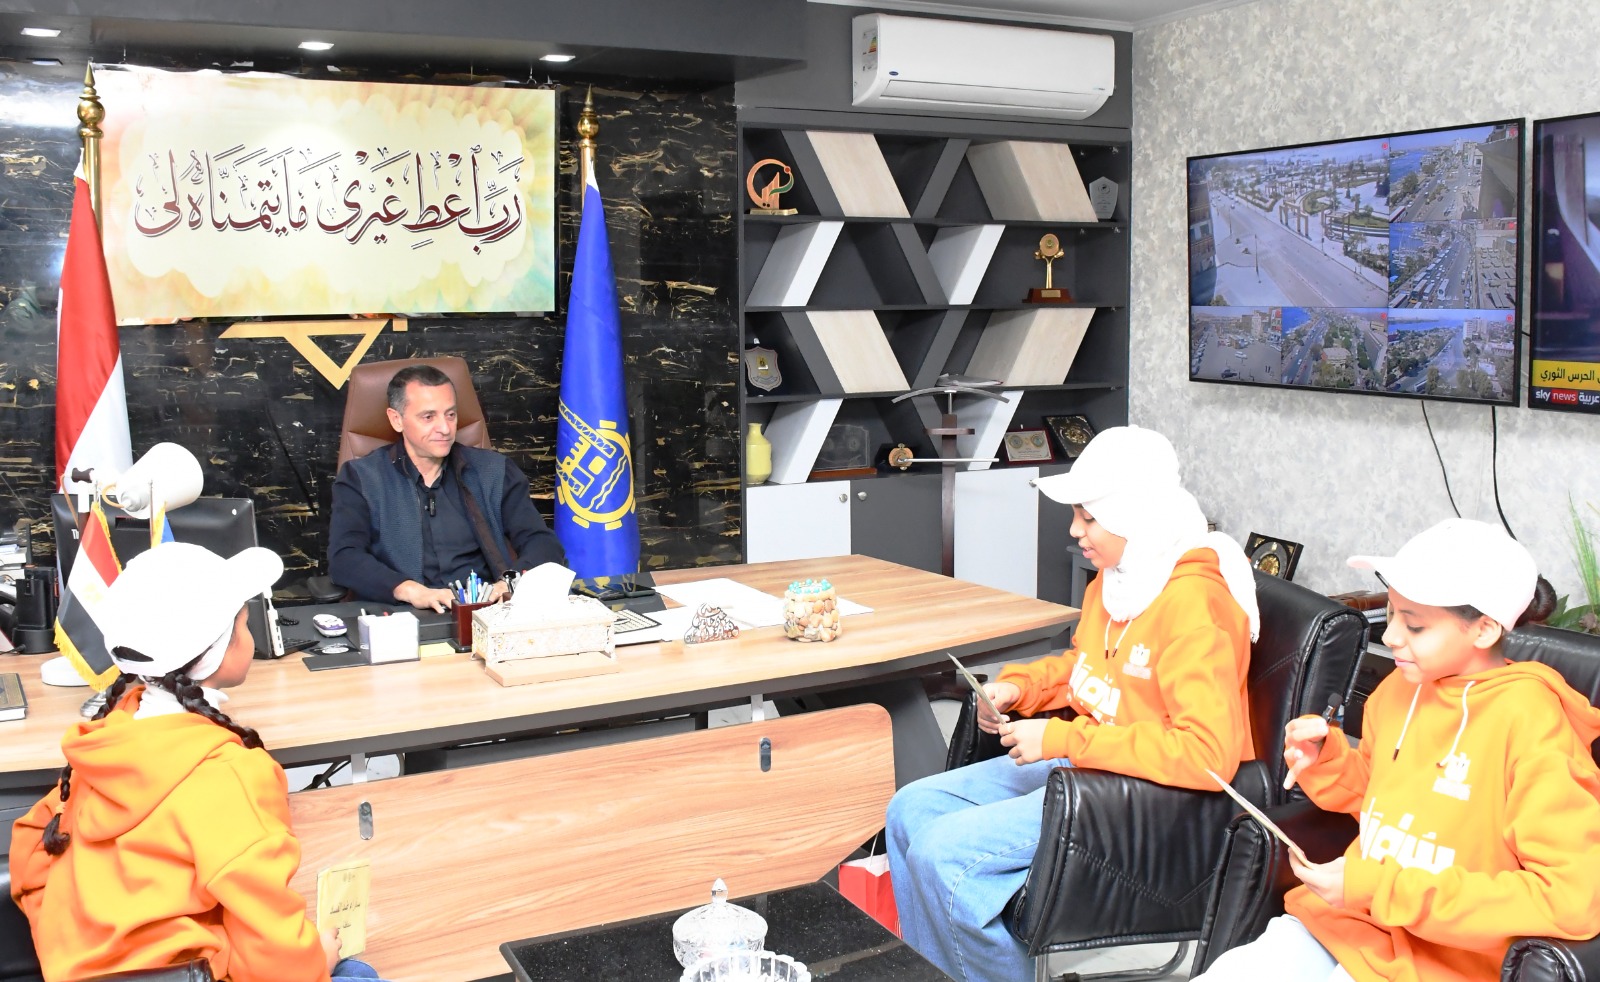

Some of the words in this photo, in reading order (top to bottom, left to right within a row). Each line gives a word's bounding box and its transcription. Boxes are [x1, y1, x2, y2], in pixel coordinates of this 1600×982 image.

[1540, 367, 1566, 382] الثوري
[1567, 369, 1595, 383] الحرس
[1535, 389, 1551, 402] sky
[1552, 391, 1577, 402] news
[1578, 391, 1600, 405] عربية
